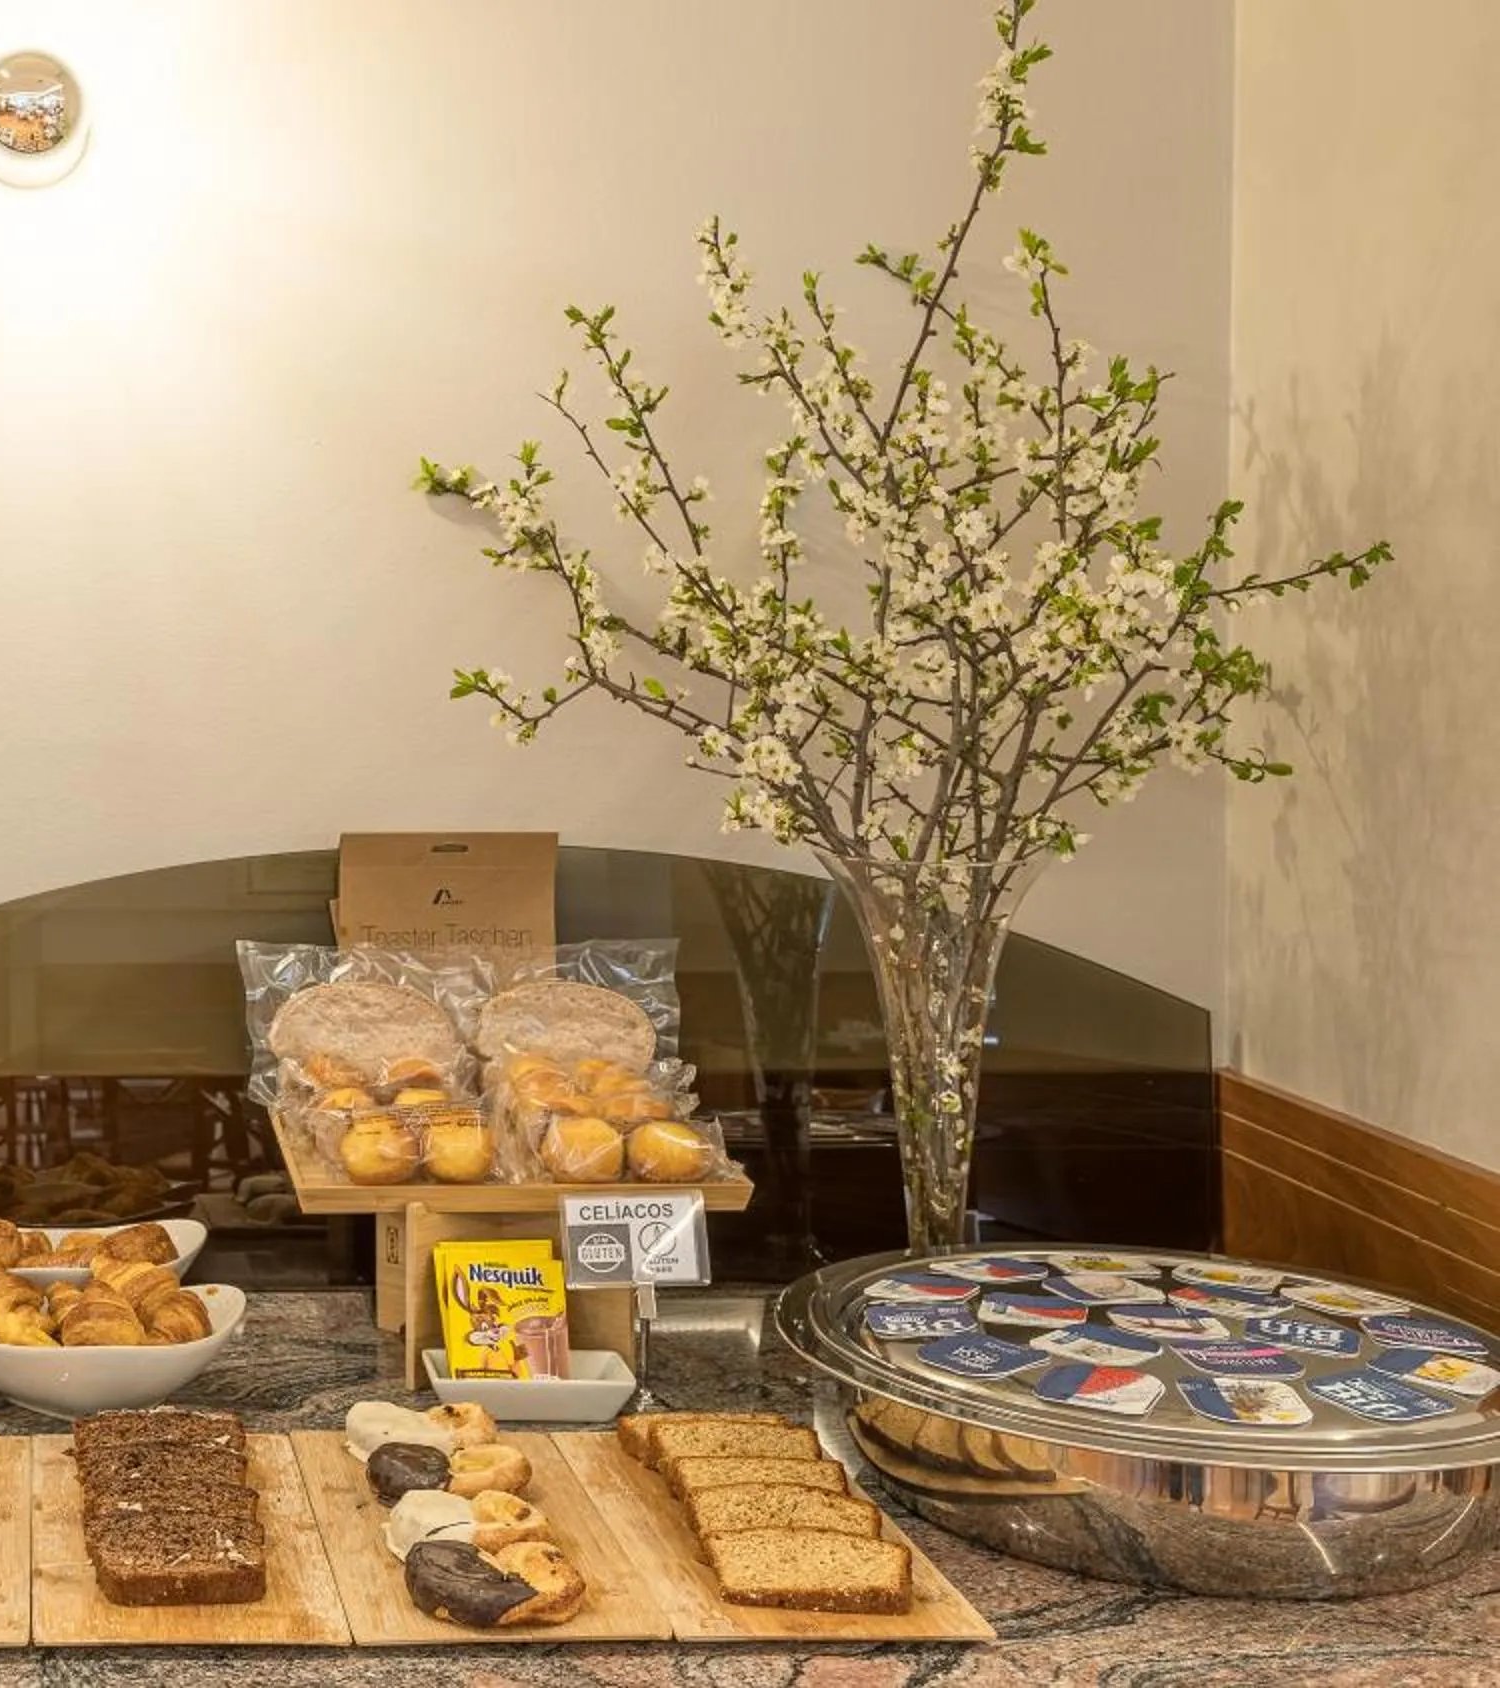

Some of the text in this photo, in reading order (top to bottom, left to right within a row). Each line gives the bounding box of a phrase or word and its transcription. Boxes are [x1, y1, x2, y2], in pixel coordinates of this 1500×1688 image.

[444, 923, 533, 948] Taschen
[581, 1246, 622, 1260] GLUTEN
[643, 1256, 679, 1265] LUTEN
[469, 1263, 545, 1289] Nesquik
